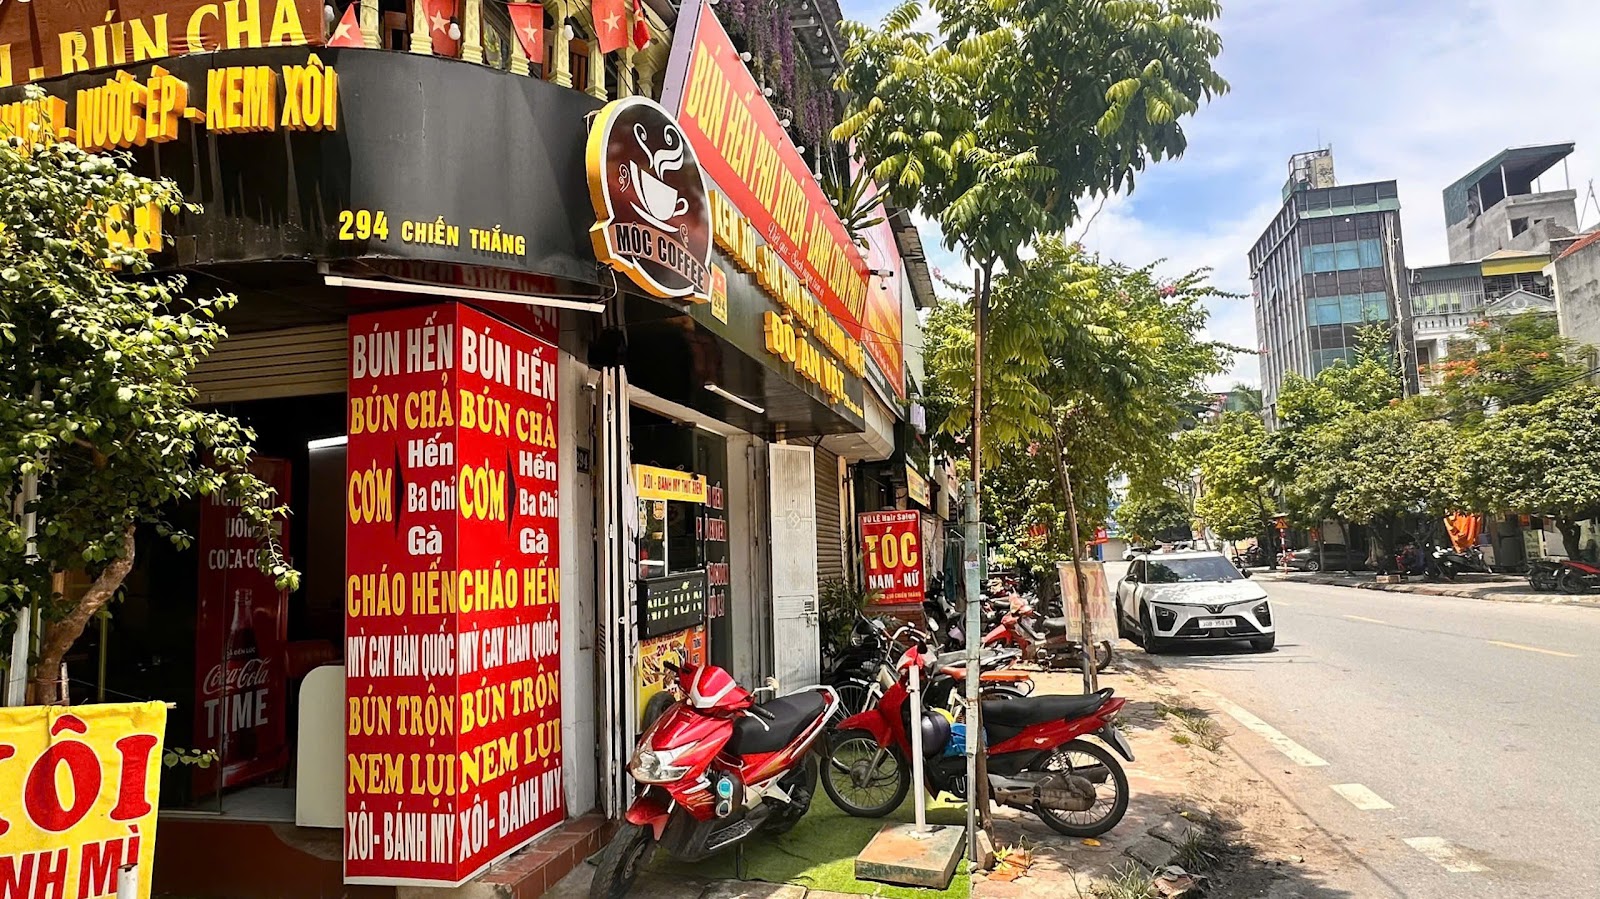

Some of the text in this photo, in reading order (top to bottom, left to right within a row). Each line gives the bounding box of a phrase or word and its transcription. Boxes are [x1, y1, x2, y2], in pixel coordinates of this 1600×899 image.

[59, 10, 169, 75] BÚN
[77, 70, 147, 149] NƯỚC
[146, 65, 187, 141] ÉP
[207, 66, 276, 133] KEM
[281, 53, 337, 131] XÔI
[685, 39, 730, 149] BÚN
[721, 90, 758, 192] HẾN
[755, 131, 782, 213] PHÚ
[772, 162, 809, 250] XUYÊN
[807, 209, 833, 281] BÁNH
[339, 210, 527, 256] 294 CHIẾN THẮNG
[615, 223, 706, 290] MỘC COFFEE
[712, 189, 739, 255] KEM
[741, 217, 757, 273] XÔI
[353, 323, 400, 379] BÚN
[406, 311, 453, 374] HẾN
[461, 327, 556, 401] BÚN HẾN
[768, 309, 796, 363] ĐỒ
[799, 328, 821, 385] ĂN
[350, 372, 454, 435] BÚN CHẢ
[459, 386, 557, 449] BÚN CHẢ
[407, 432, 453, 468] Hến
[519, 450, 557, 482] Hến
[348, 459, 393, 524] CƠM
[407, 476, 456, 513] Ba Chỉ
[458, 457, 505, 521] CƠM
[519, 486, 559, 519] Ba Chỉ
[407, 525, 442, 555] Gà
[519, 527, 549, 554] Gà
[864, 526, 918, 569] TÓC
[348, 557, 457, 618] CHÁO HẾN
[458, 556, 560, 614] CHÁO HẾN
[868, 574, 894, 590] NAM
[347, 618, 455, 681] MỲ CAY HÀN QUỐC
[459, 607, 559, 676] MỲ CAY HÀN QUỐC
[204, 688, 269, 738] TIME
[349, 682, 456, 748] BÚN TRỘN
[459, 663, 559, 734] BÚN TRỘN
[0, 714, 158, 836] ÔI
[348, 753, 456, 808] NEM LỤI
[459, 717, 561, 794] NEM LỤI
[498, 774, 538, 839] BÁNH
[541, 758, 562, 816] MỲ
[383, 801, 427, 862] BÁNH
[430, 803, 457, 865] MỲ
